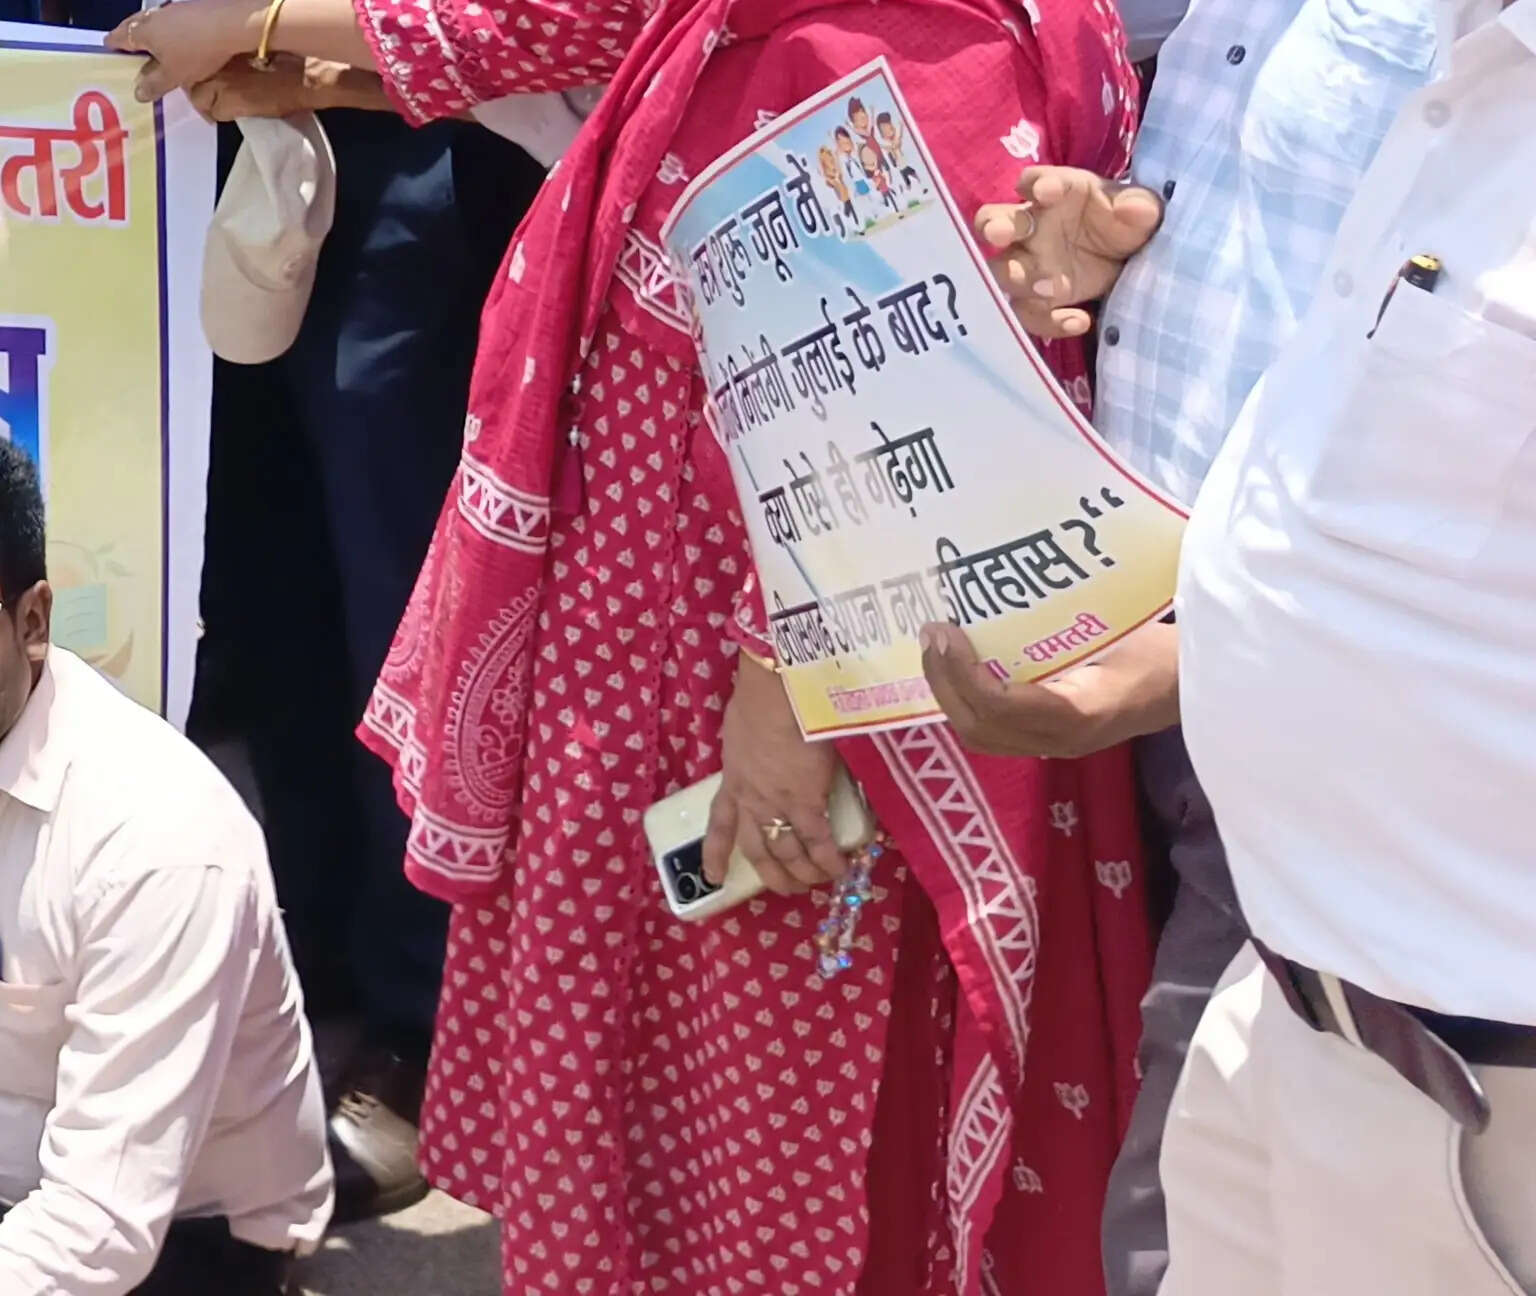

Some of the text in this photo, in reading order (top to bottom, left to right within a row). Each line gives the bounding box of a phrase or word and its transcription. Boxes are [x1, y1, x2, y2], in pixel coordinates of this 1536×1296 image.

[741, 190, 798, 282] जून
[781, 297, 856, 421] जुलाई
[843, 287, 886, 371] के
[1023, 612, 1109, 663] धमतरी
